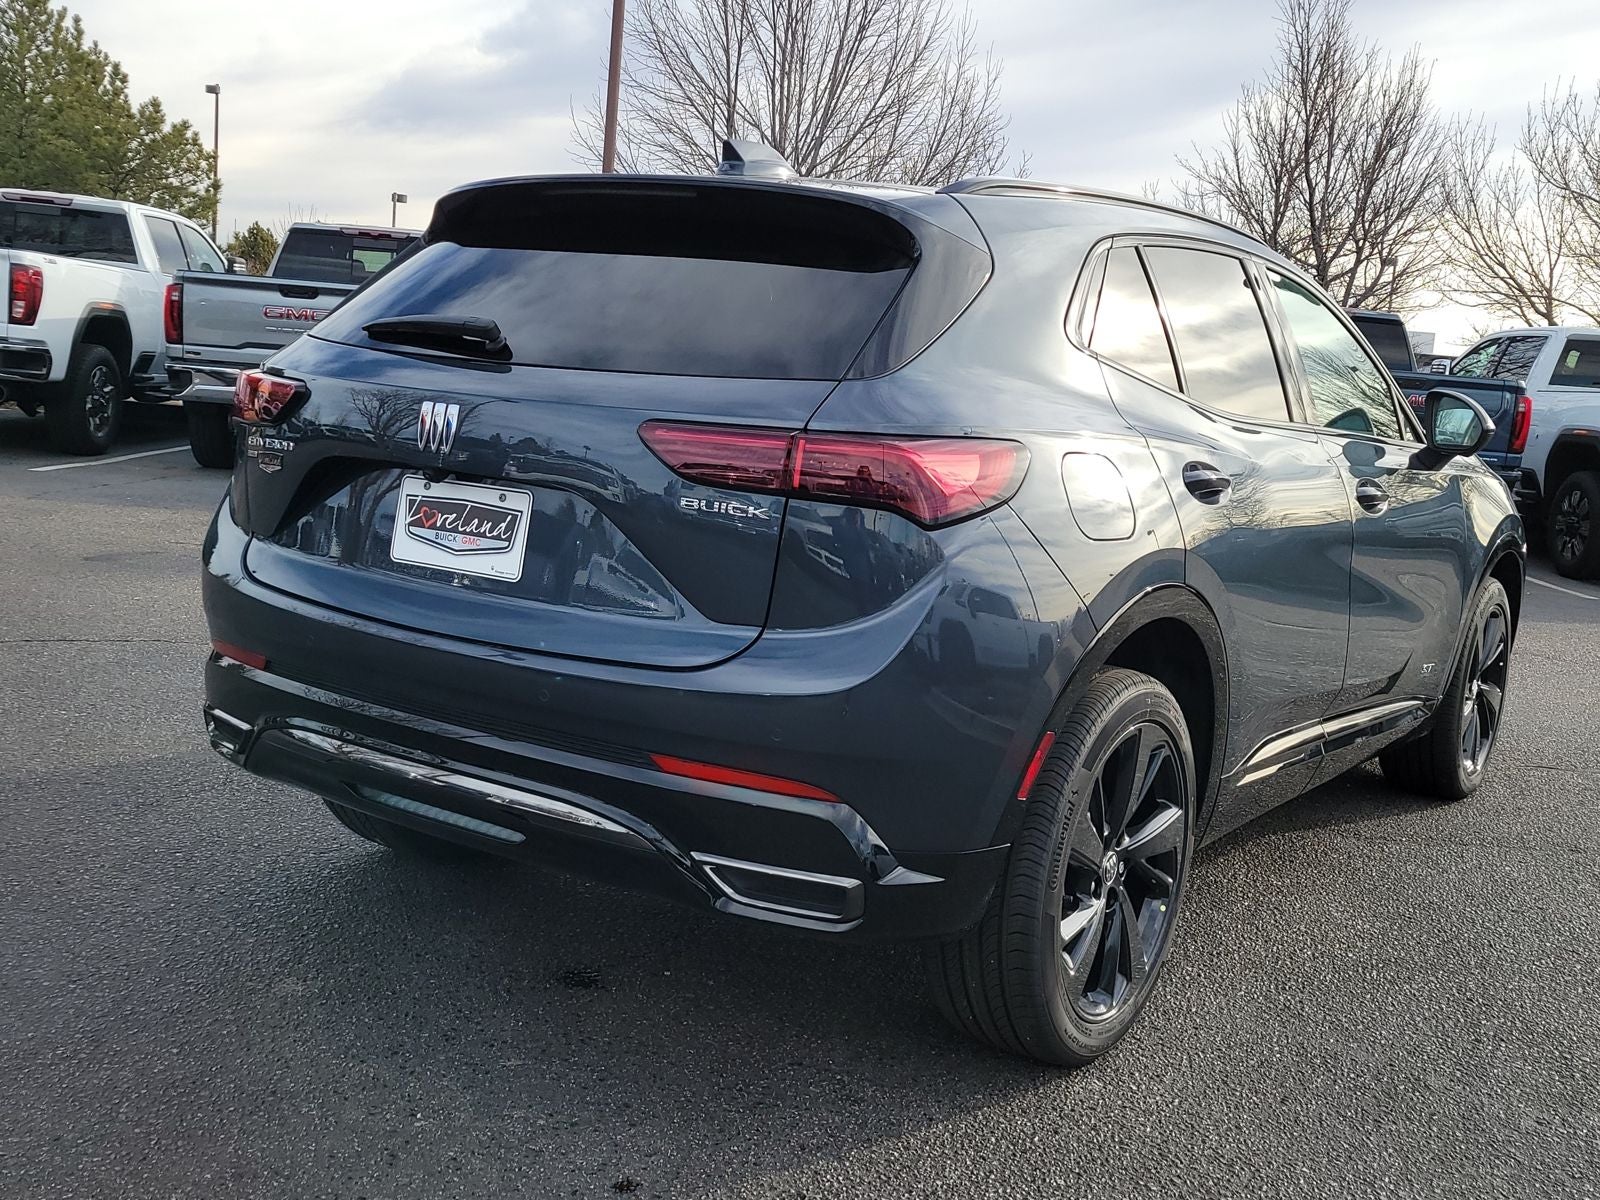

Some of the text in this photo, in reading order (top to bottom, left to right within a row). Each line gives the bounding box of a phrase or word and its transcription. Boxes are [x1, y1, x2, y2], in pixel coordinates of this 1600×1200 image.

[263, 305, 330, 323] GMC
[680, 497, 770, 519] BUICK
[434, 532, 481, 547] BUICK GMC
